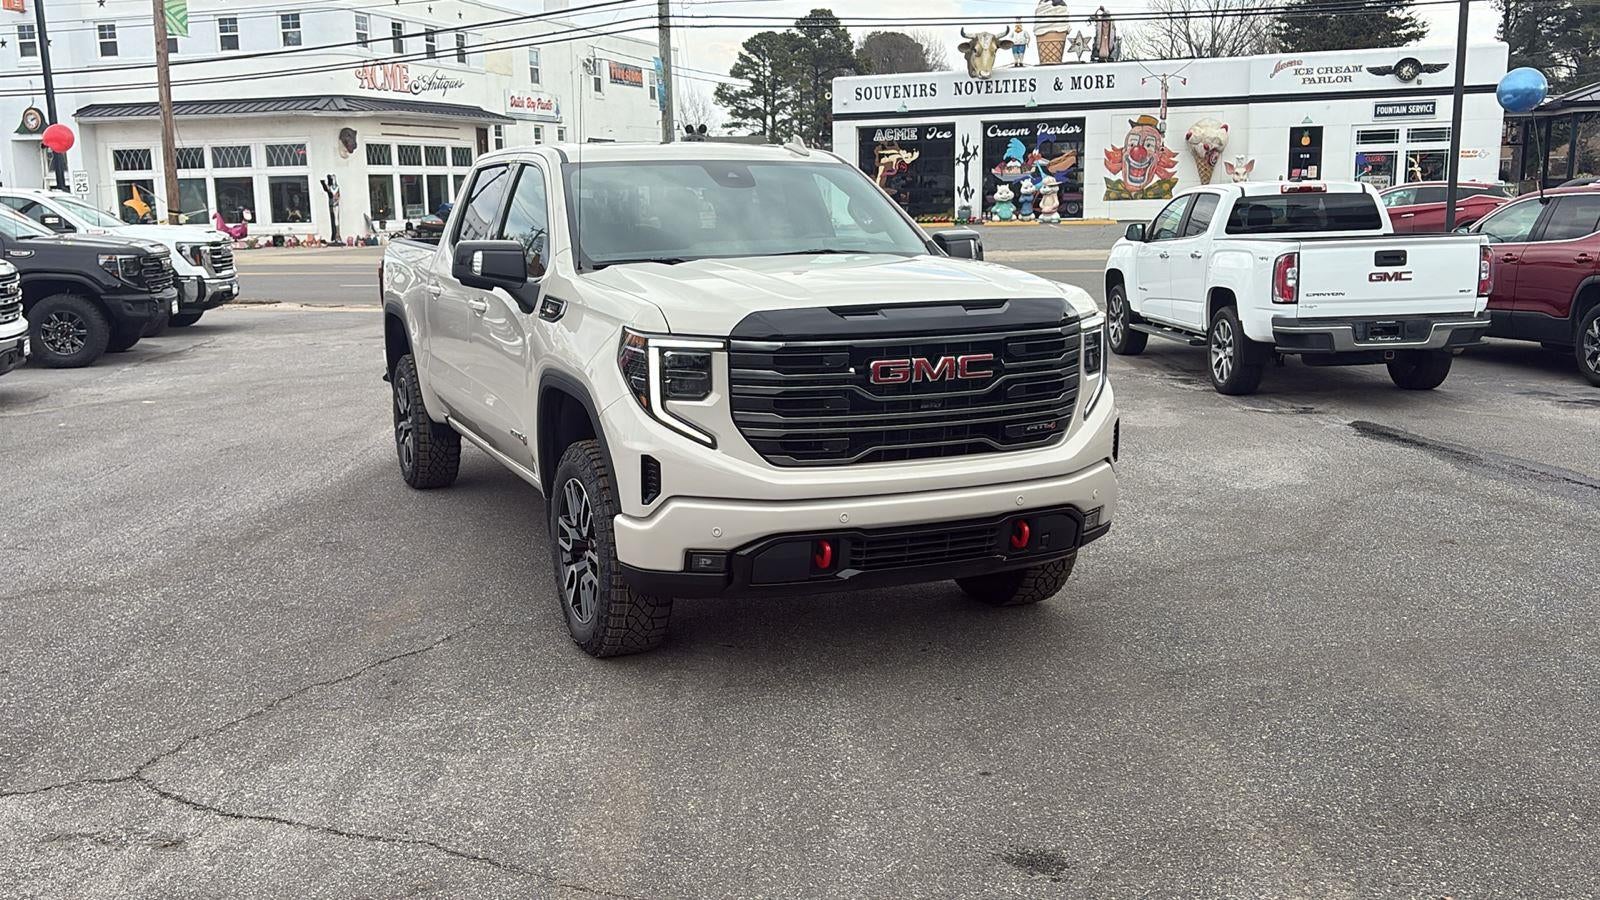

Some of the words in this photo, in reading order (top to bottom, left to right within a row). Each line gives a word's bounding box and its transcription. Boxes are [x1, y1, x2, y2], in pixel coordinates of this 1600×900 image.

[355, 60, 410, 93] ACME
[410, 69, 464, 96] Antiques
[1293, 67, 1314, 76] ICE
[1316, 65, 1363, 75] CREAM
[855, 82, 937, 100] SOUVENIRS
[953, 78, 1037, 96] NOVELTIES
[1053, 76, 1063, 91] &
[1070, 74, 1115, 91] MORE
[1302, 75, 1353, 84] PARLOR
[526, 96, 536, 112] Boy
[1376, 105, 1407, 115] FOUNTAIN
[1408, 103, 1434, 113] SERVICE
[873, 128, 918, 141] ACME
[926, 126, 952, 139] Ice
[987, 124, 1030, 138] Cream
[1036, 122, 1082, 136] Parlor
[76, 182, 89, 192] 25
[1368, 271, 1413, 282] GMC
[871, 354, 993, 384] GMC
